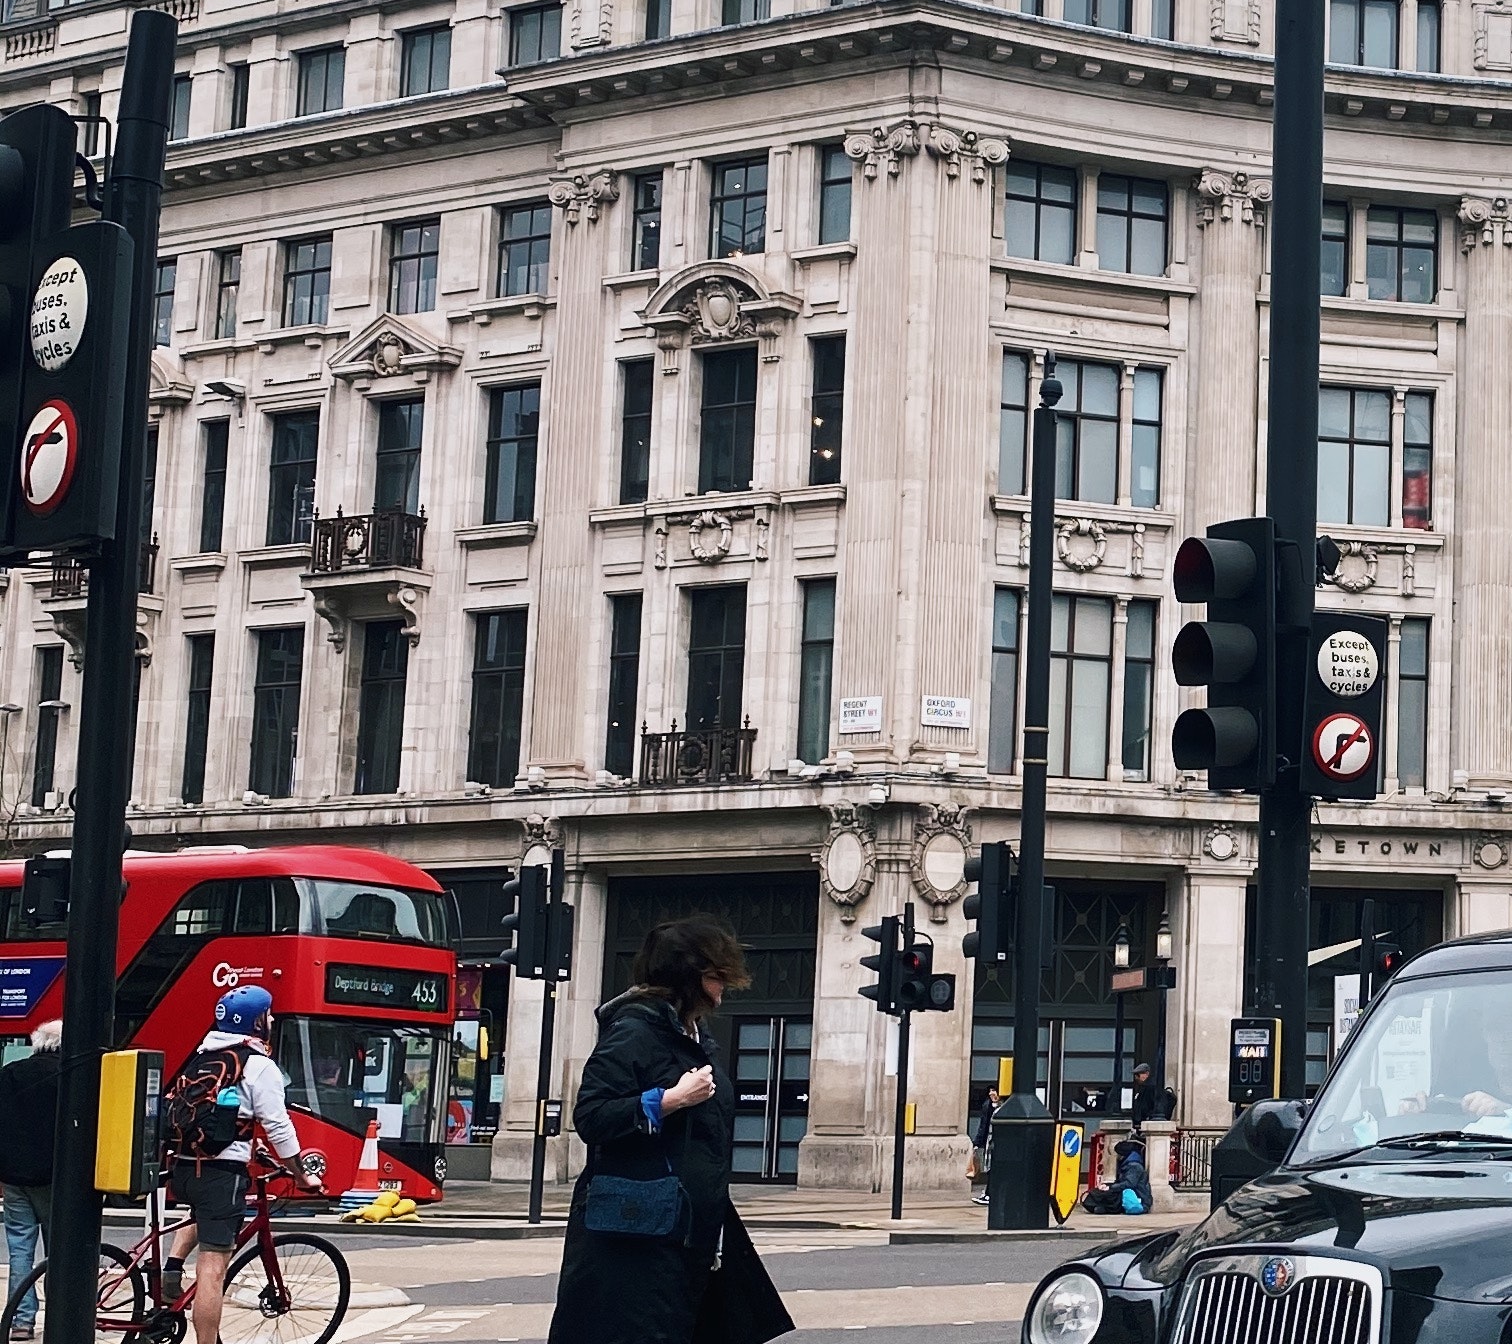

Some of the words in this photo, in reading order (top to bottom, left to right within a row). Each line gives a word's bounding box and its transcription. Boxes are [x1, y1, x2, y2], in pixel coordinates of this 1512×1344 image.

[59, 312, 71, 329] &
[1329, 638, 1370, 652] Except
[1363, 667, 1371, 678] &
[1329, 680, 1368, 693] cycles
[843, 700, 868, 709] REGENT
[926, 698, 956, 709] OXFORD
[843, 709, 866, 718] STREET
[926, 707, 953, 717] CIRCUS
[1310, 838, 1442, 857] KETOWN
[212, 962, 239, 987] Go
[334, 975, 369, 993] Deptford
[370, 979, 394, 996] Bridge
[411, 979, 438, 1003] 453
